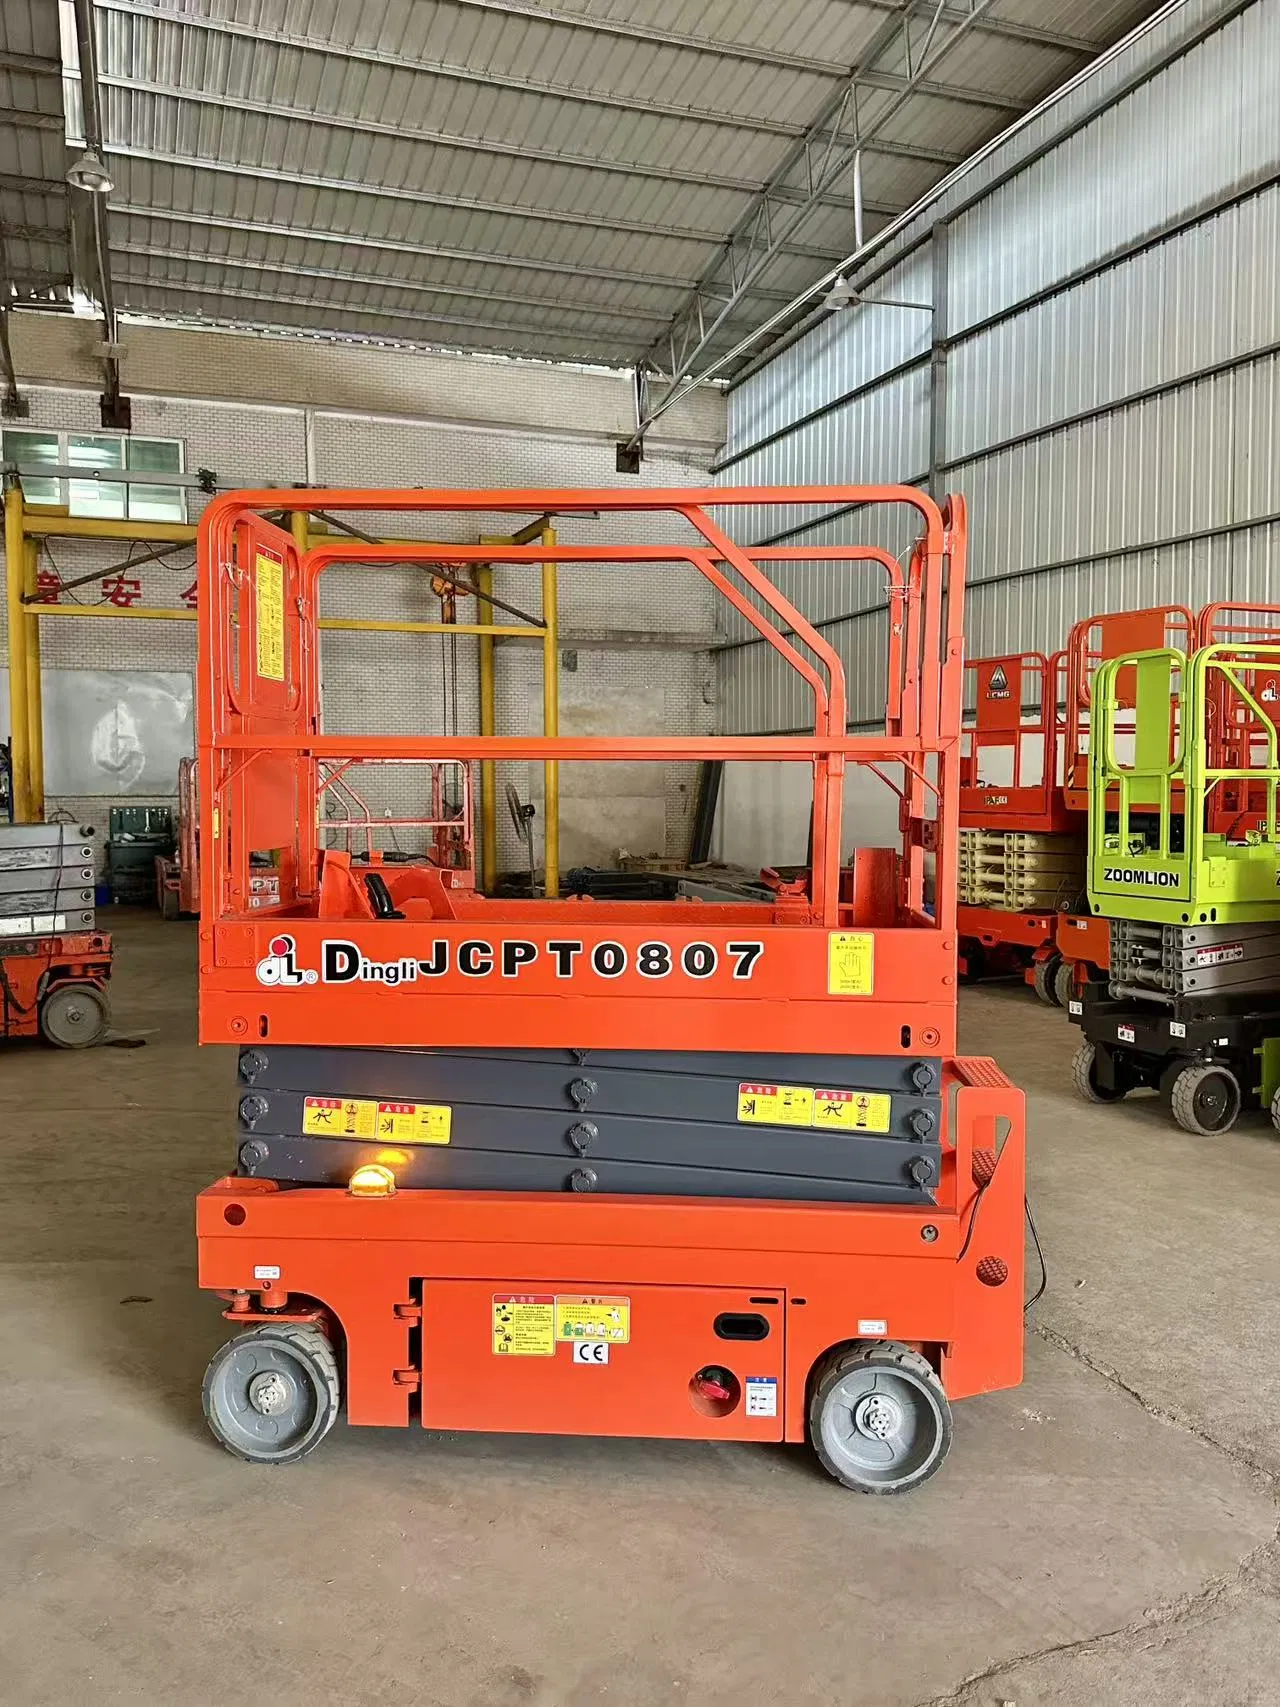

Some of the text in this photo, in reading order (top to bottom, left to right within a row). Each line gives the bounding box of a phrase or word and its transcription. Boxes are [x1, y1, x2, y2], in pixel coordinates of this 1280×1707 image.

[1103, 867, 1181, 888] ZOOMLION
[323, 940, 765, 986] Dingli JCPT0807
